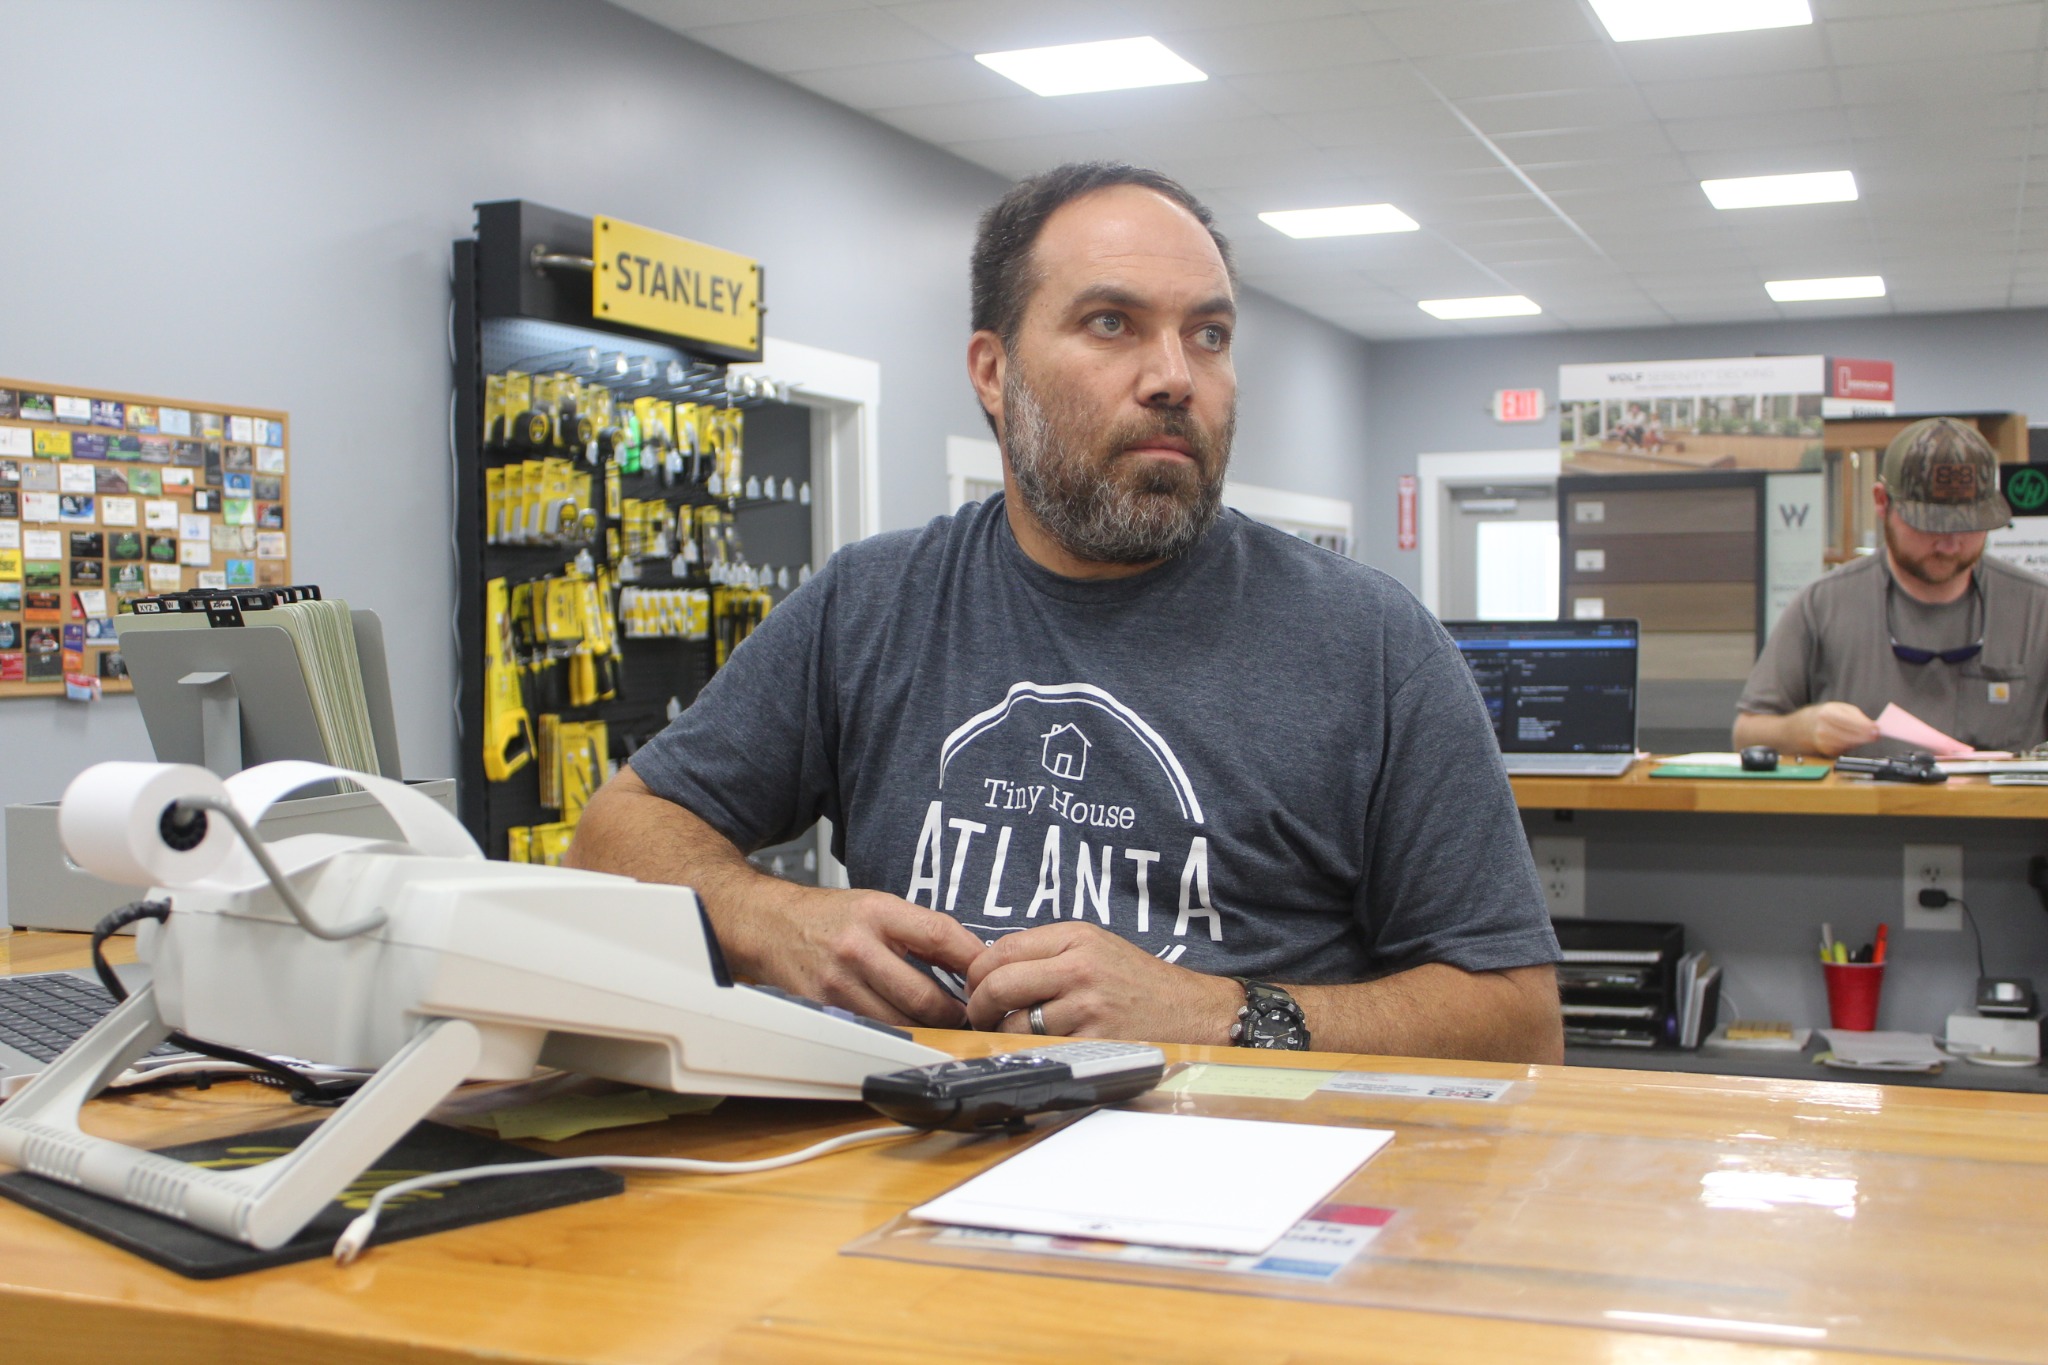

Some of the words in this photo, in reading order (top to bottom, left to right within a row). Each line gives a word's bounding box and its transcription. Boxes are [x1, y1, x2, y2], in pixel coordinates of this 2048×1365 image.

[616, 251, 744, 316] STANLEY
[1608, 373, 1643, 382] WOLF
[1503, 390, 1537, 419] EXIT
[1779, 504, 1809, 527] W
[139, 602, 155, 612] XYZ
[984, 778, 1045, 814] Tiny
[1048, 784, 1136, 829] House
[905, 801, 1223, 941] ATLANTA
